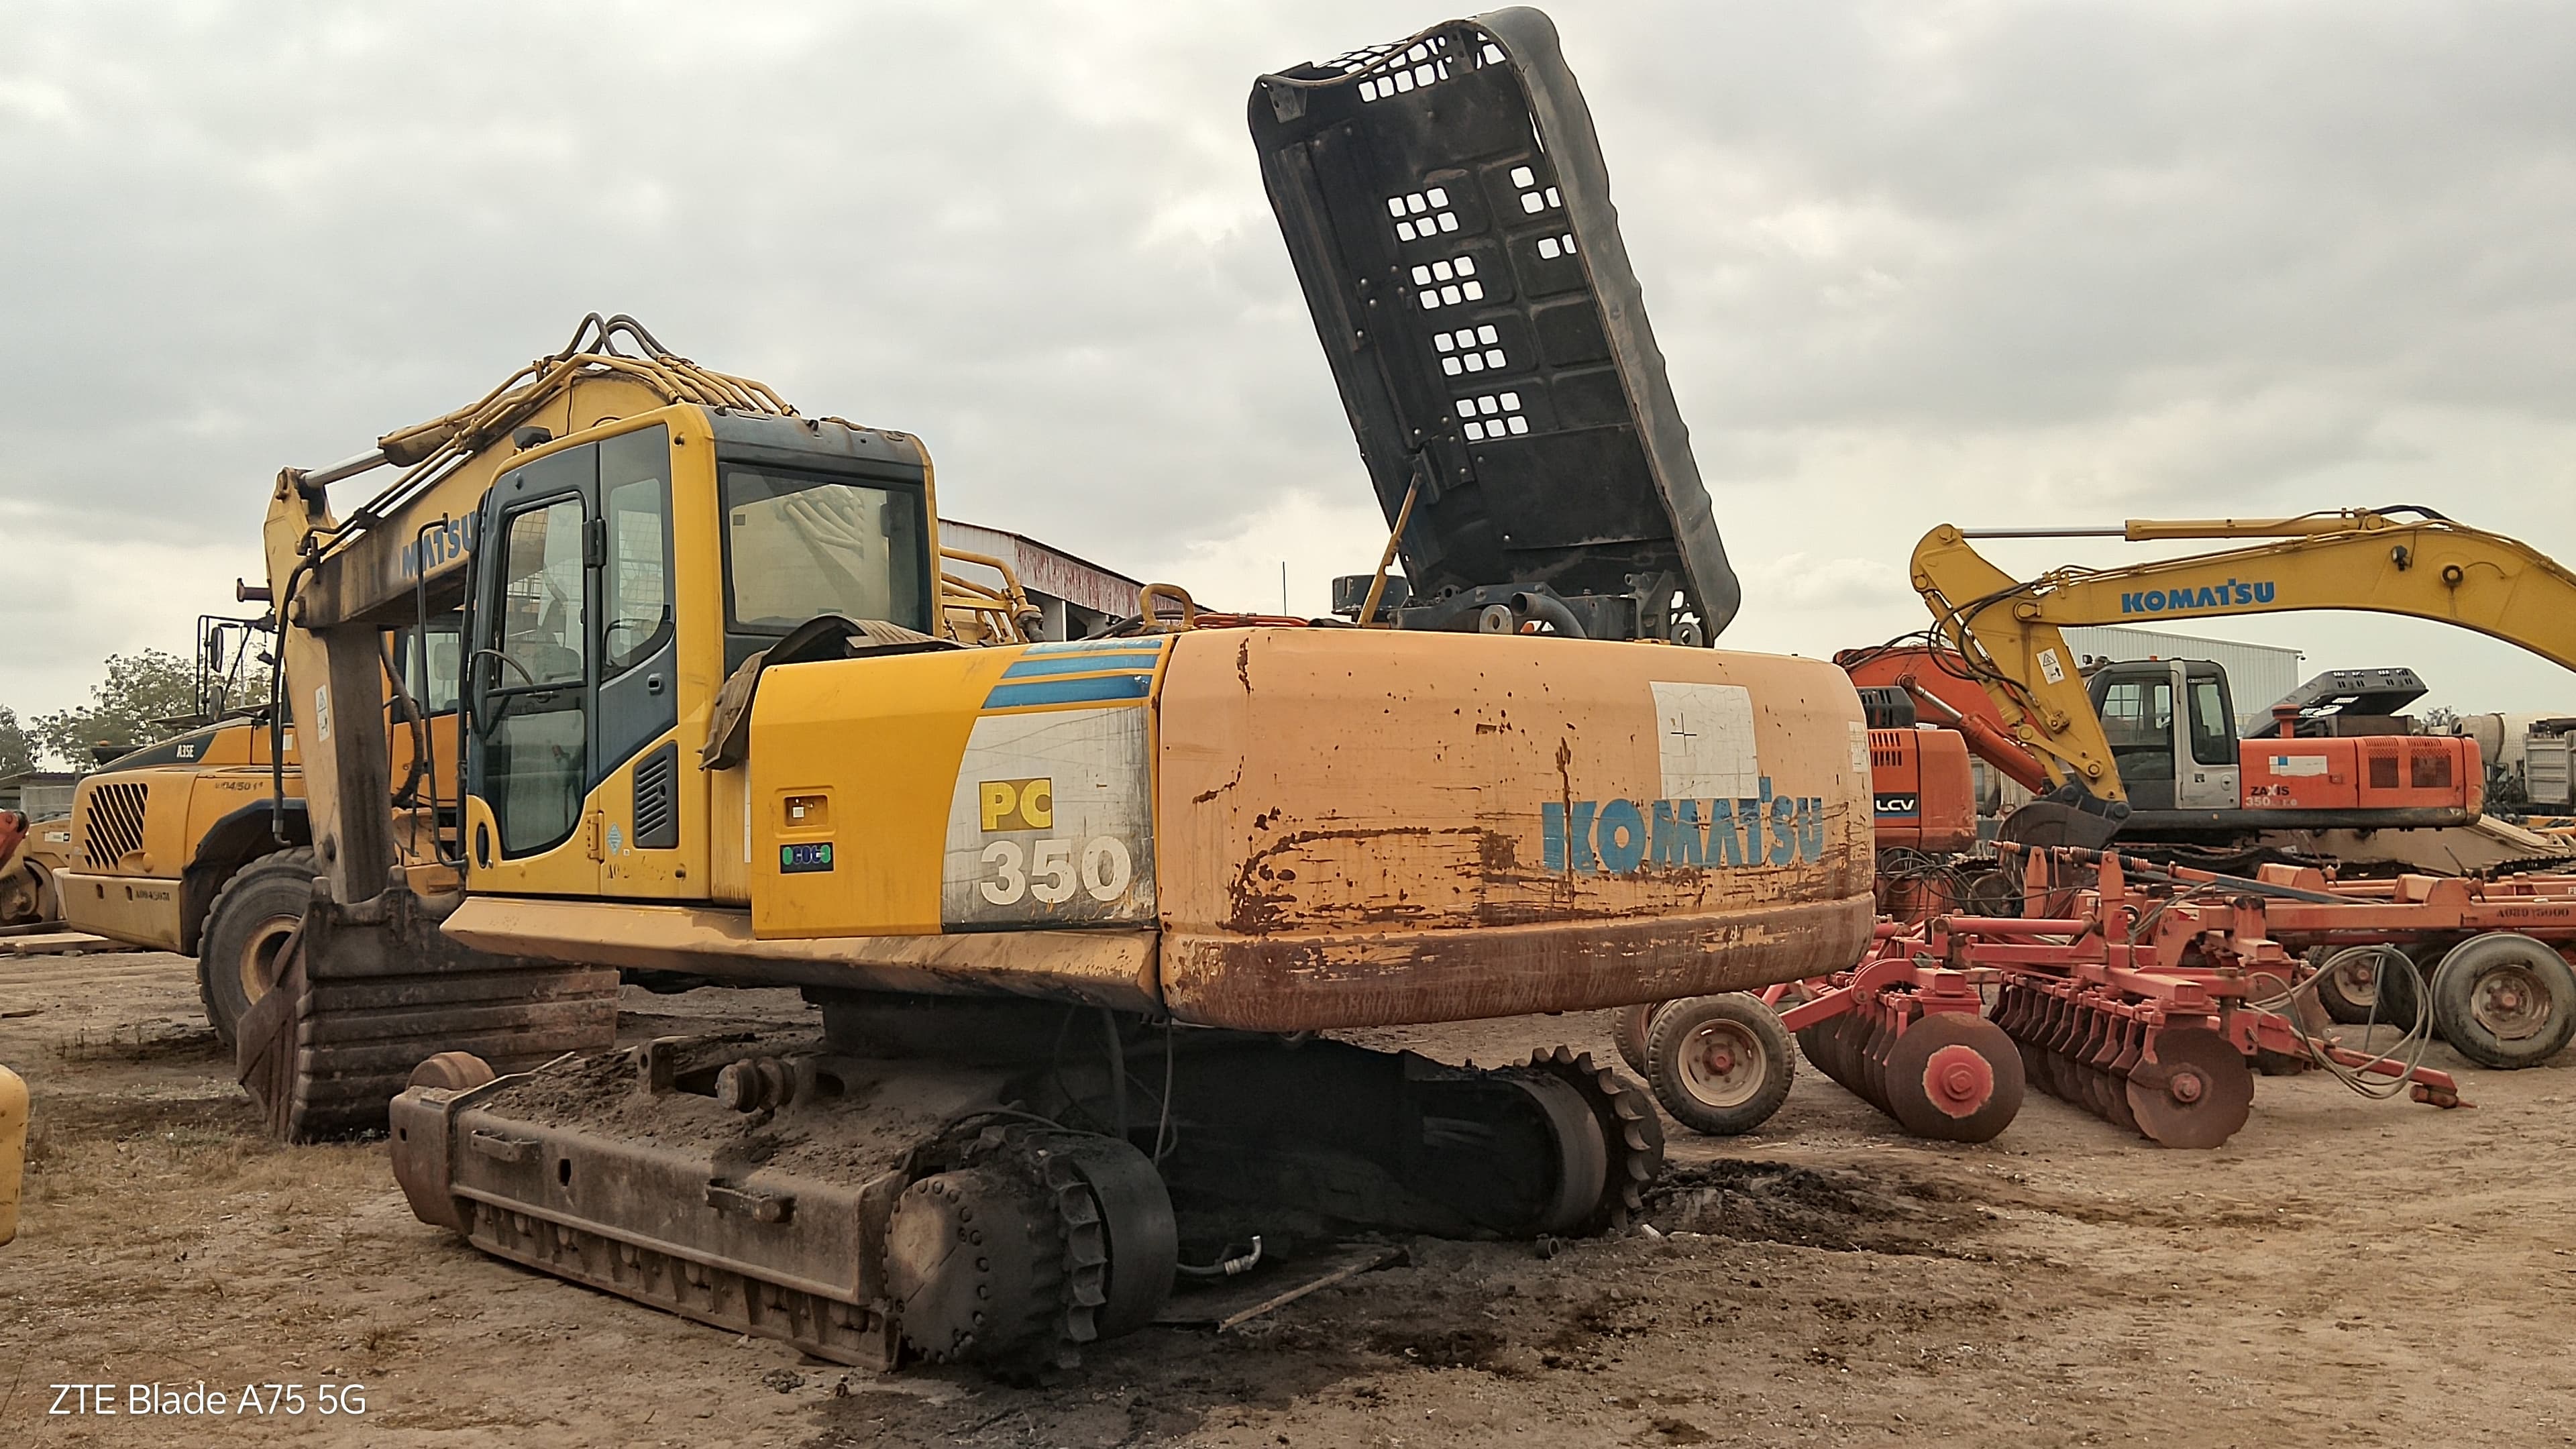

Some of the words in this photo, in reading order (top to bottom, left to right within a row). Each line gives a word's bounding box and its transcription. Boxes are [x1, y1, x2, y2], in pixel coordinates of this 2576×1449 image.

[2121, 578, 2275, 613] KOMATSU
[176, 744, 194, 758] A35E
[981, 779, 1052, 830] PC
[1876, 800, 1915, 811] LCV
[2250, 784, 2290, 796] ZAXIS
[1542, 776, 1823, 874] KOMATSU
[980, 836, 1132, 905] 350
